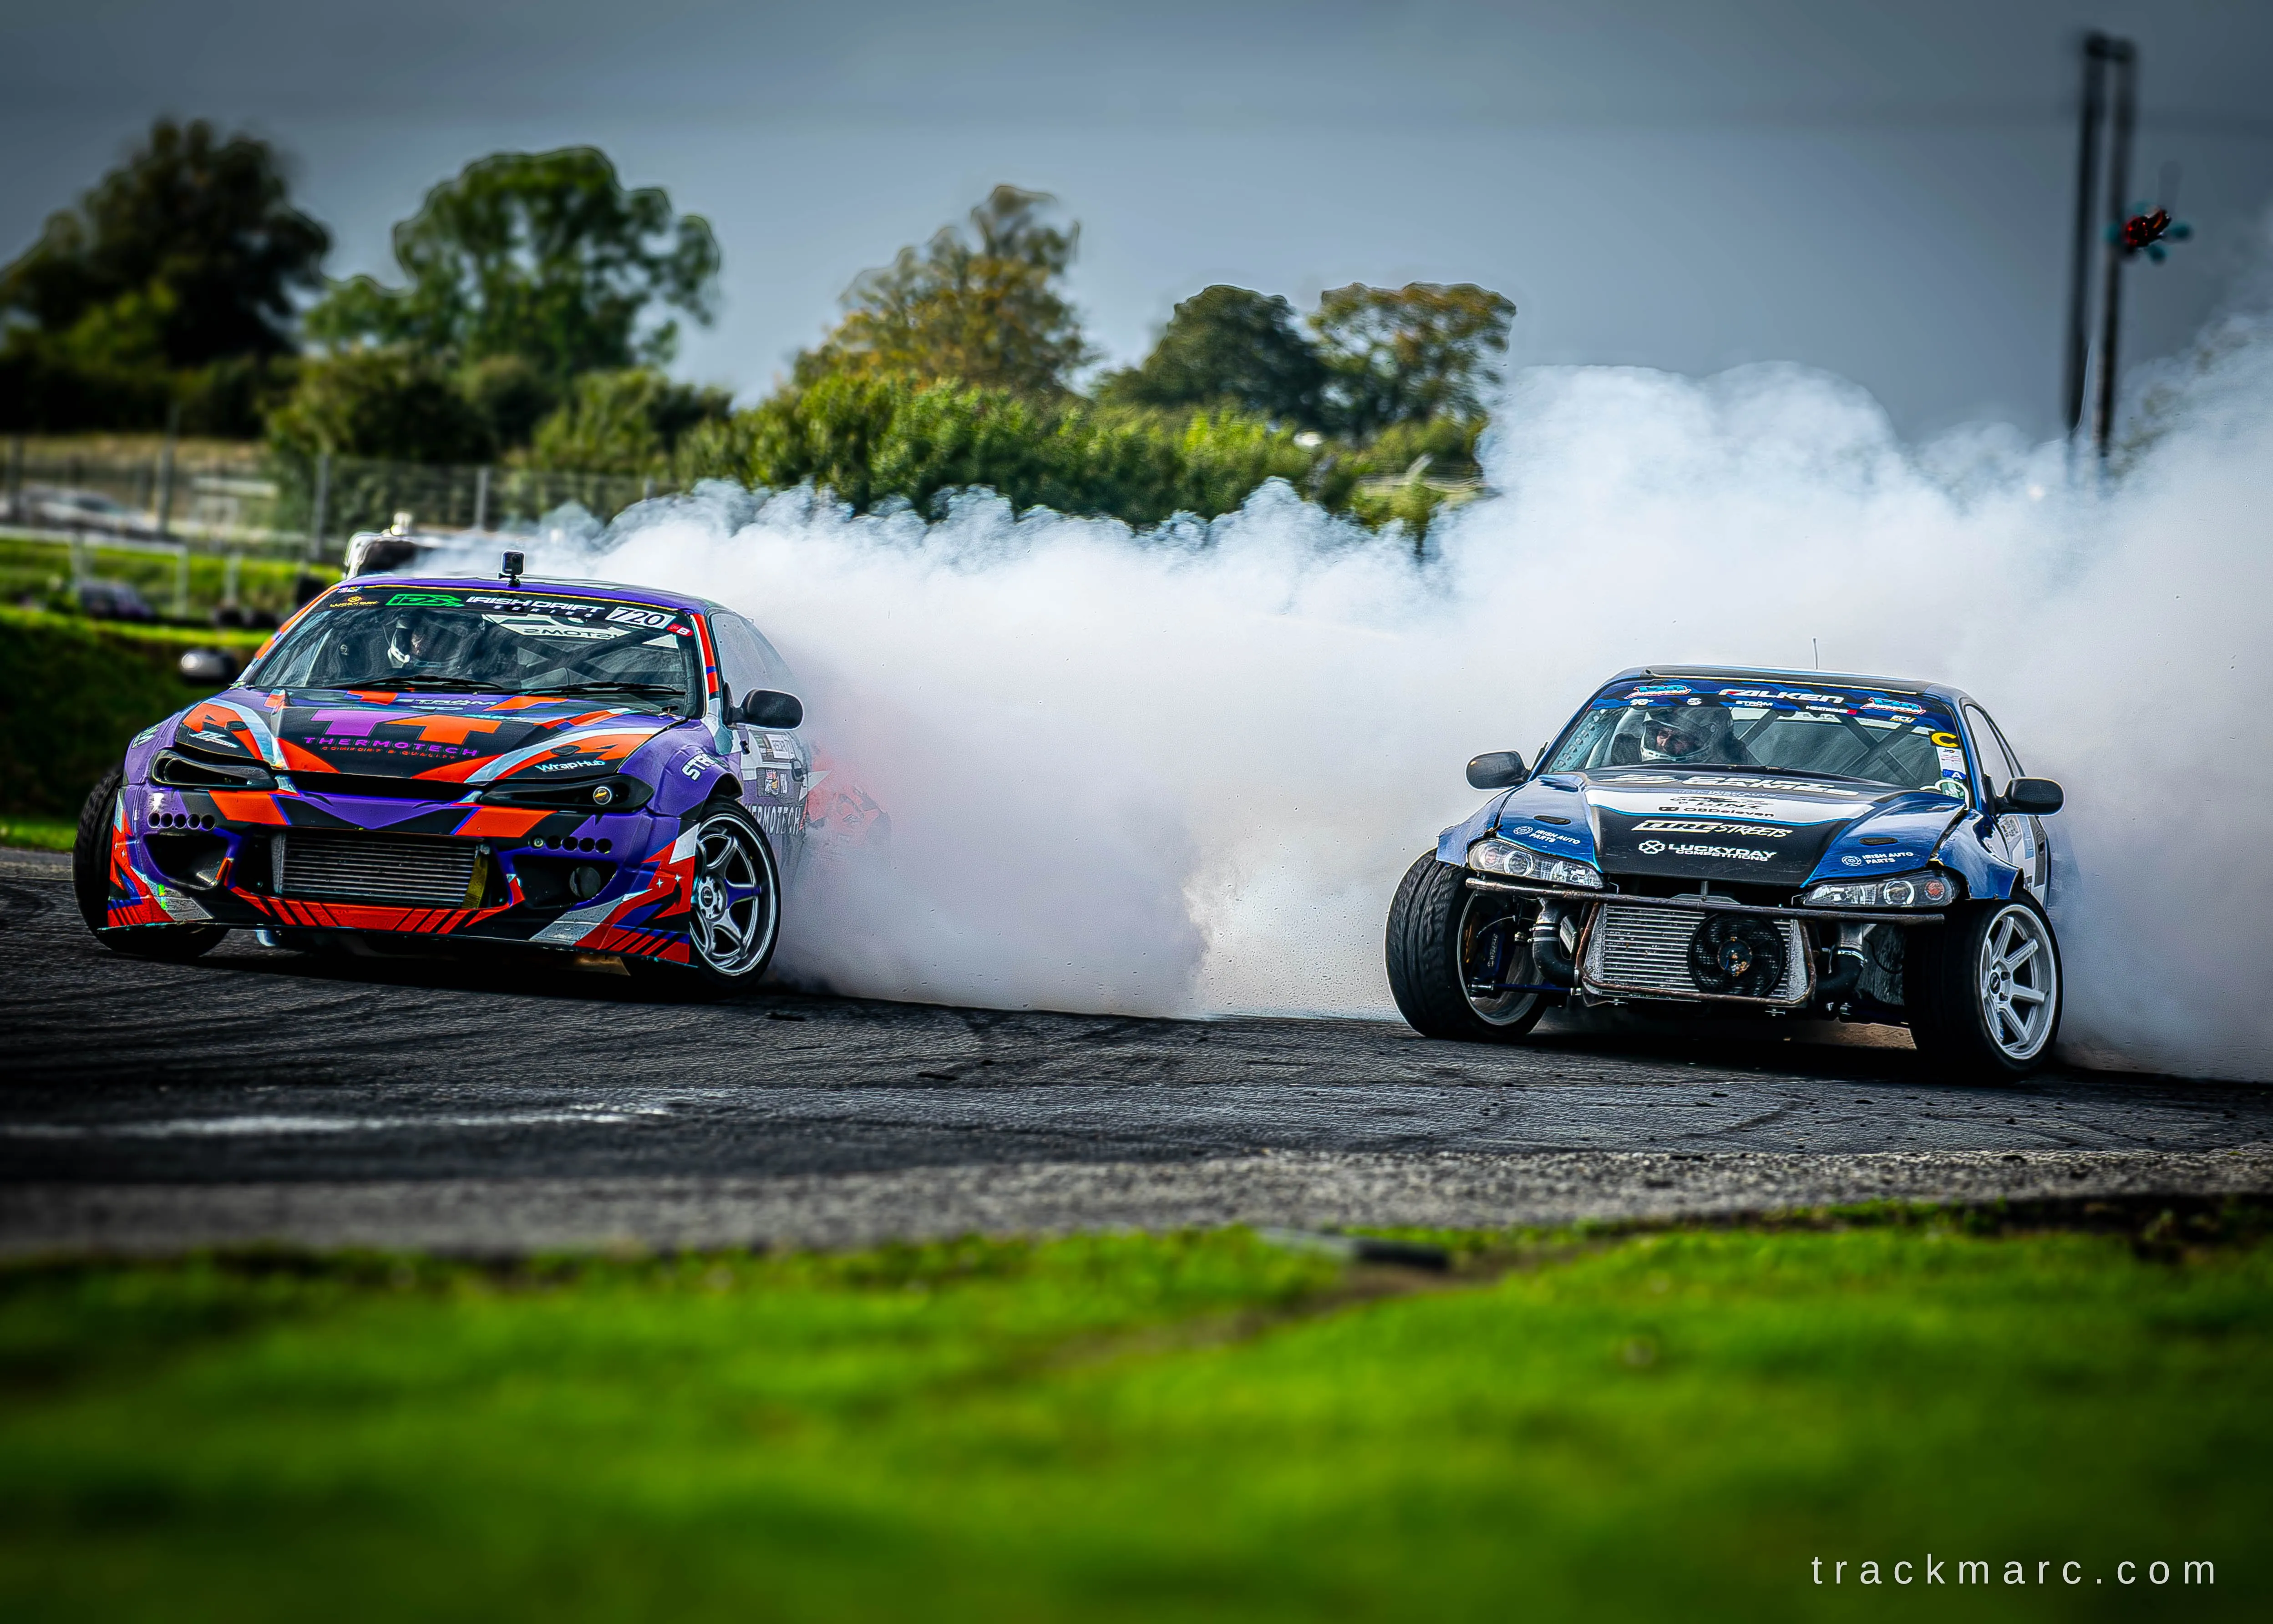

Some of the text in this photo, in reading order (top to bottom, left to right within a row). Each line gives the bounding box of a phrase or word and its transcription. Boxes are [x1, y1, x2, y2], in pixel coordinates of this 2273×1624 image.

[466, 596, 605, 613] IRISH DRIFT
[609, 608, 665, 625] 720
[1718, 689, 1844, 703] FALKEN
[304, 737, 478, 757] THERMOTECH
[1932, 733, 1958, 747] C
[1682, 780, 1860, 796] GAMES
[1684, 807, 1775, 817] OBDeleven
[1528, 833, 1556, 843] PARTS
[1534, 829, 1581, 844] IRISH AUTO
[1675, 850, 1769, 862] COMPETITIONS
